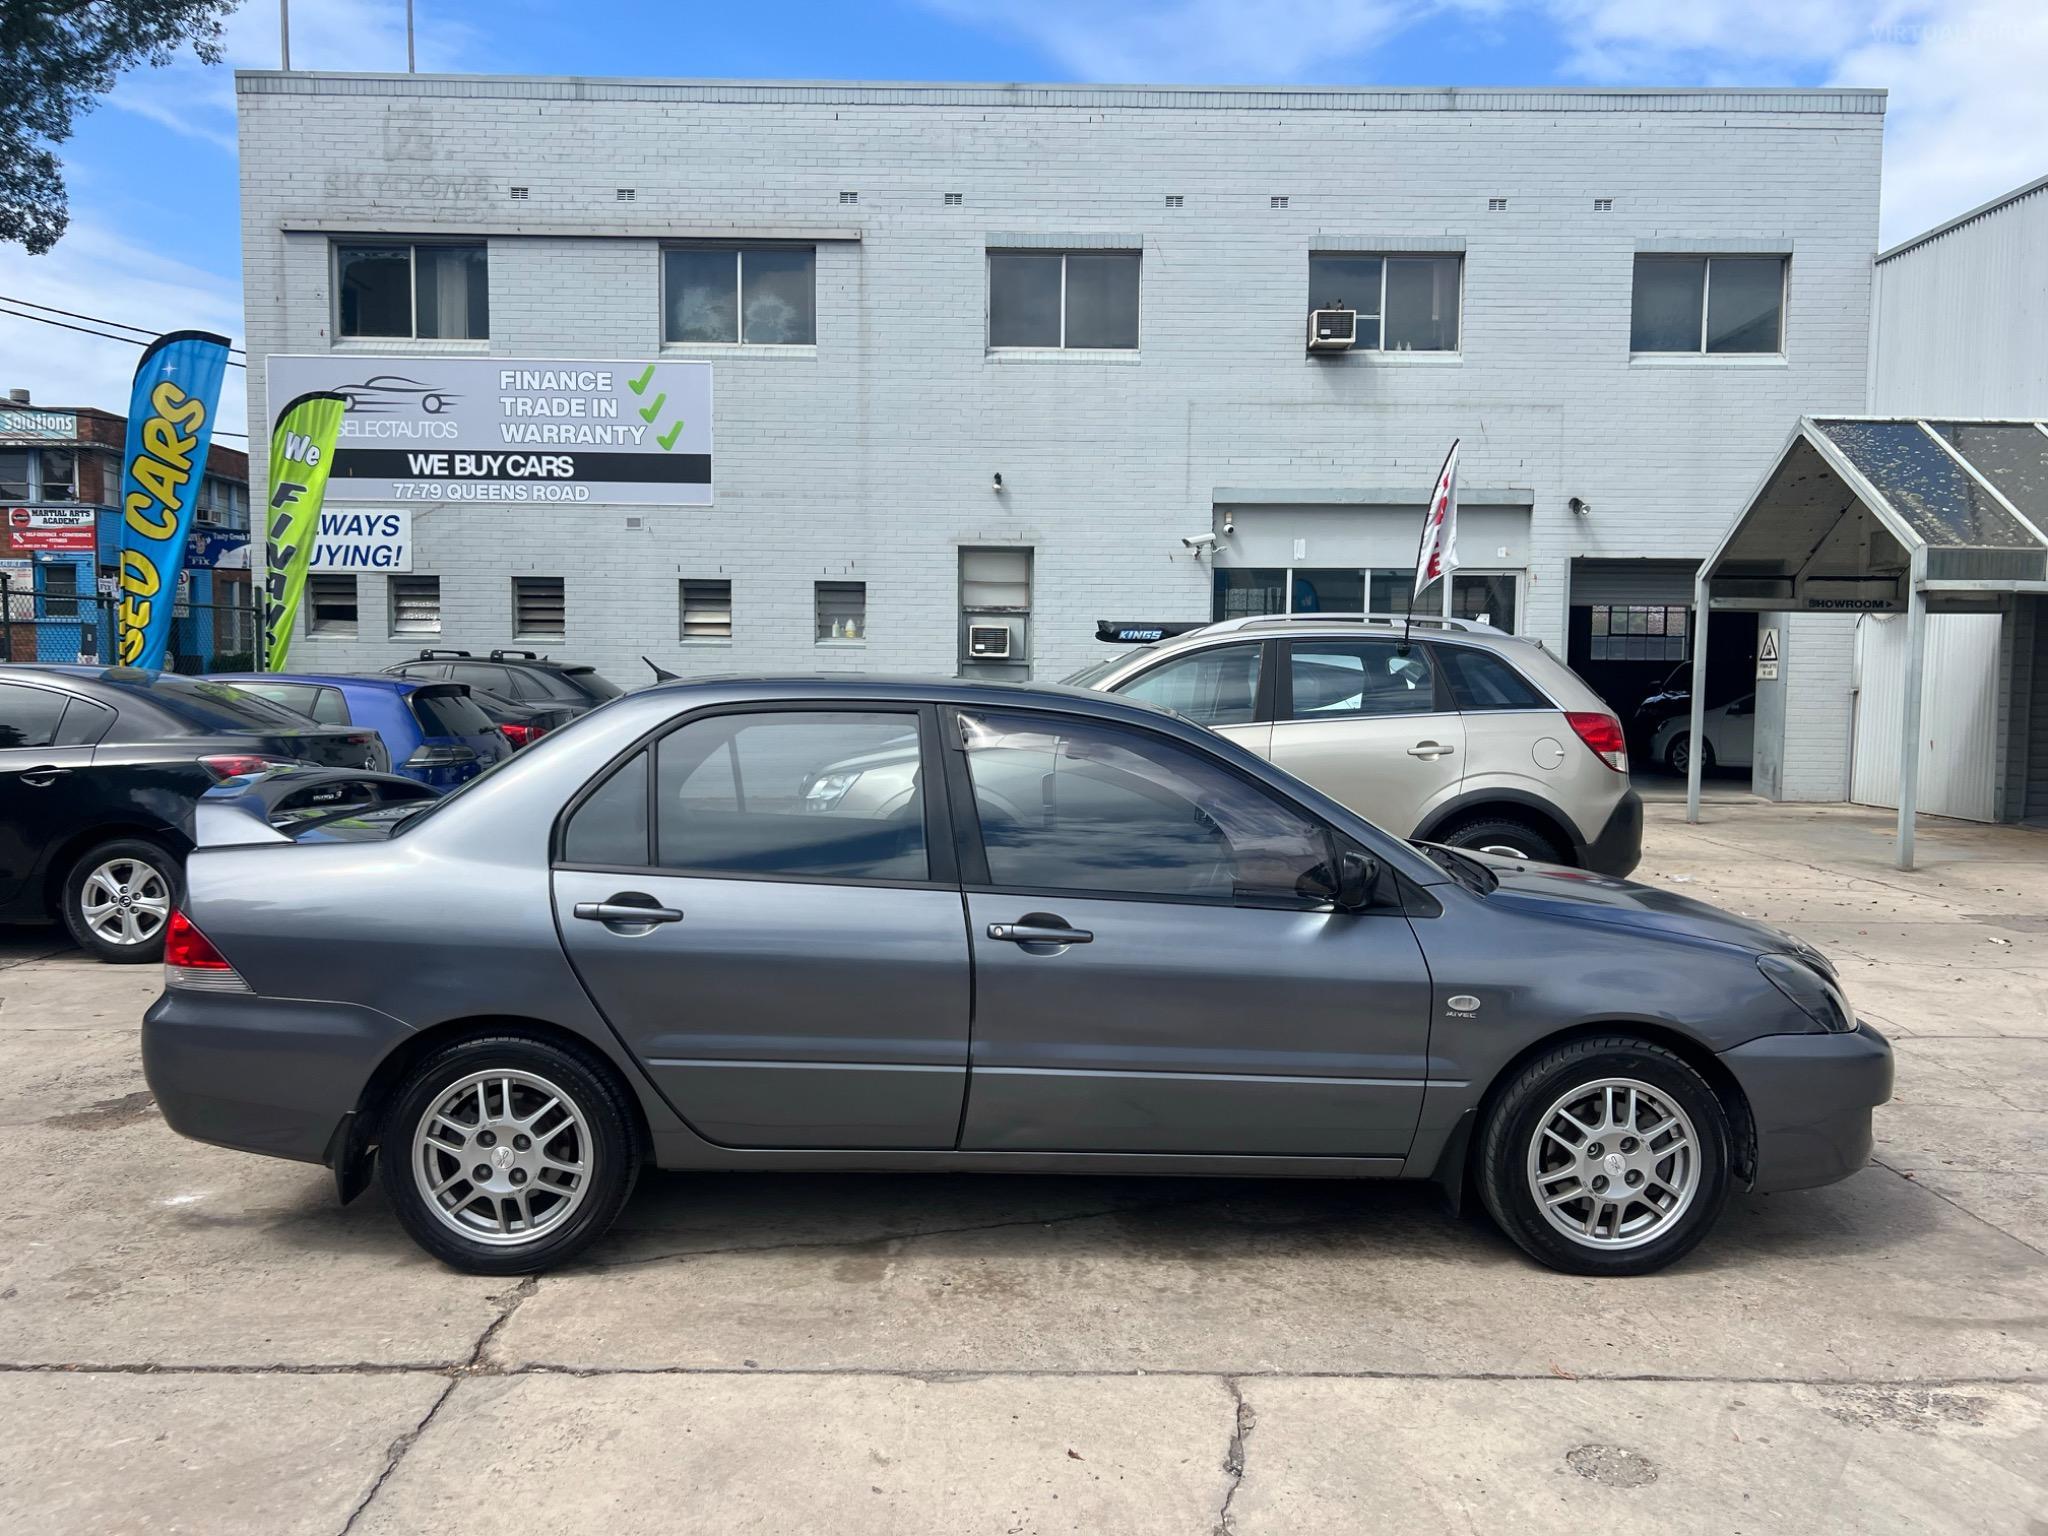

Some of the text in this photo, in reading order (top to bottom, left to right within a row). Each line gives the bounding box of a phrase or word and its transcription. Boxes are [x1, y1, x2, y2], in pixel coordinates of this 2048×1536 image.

[499, 370, 613, 392] FINANCE
[499, 396, 618, 418] TRADE IN
[4, 413, 72, 430] Solutions
[499, 423, 648, 445] WARRANTY
[284, 431, 320, 467] We
[125, 381, 206, 541] CARS
[407, 454, 575, 478] WE BUY CARS
[392, 483, 590, 501] 77-79 QUEENS ROAD
[32, 509, 67, 517] MARTIAL
[316, 514, 401, 536] WAYS
[309, 544, 403, 567] UYING!
[1808, 600, 1884, 608] SHOWROOM
[1119, 630, 1162, 639] KINGS
